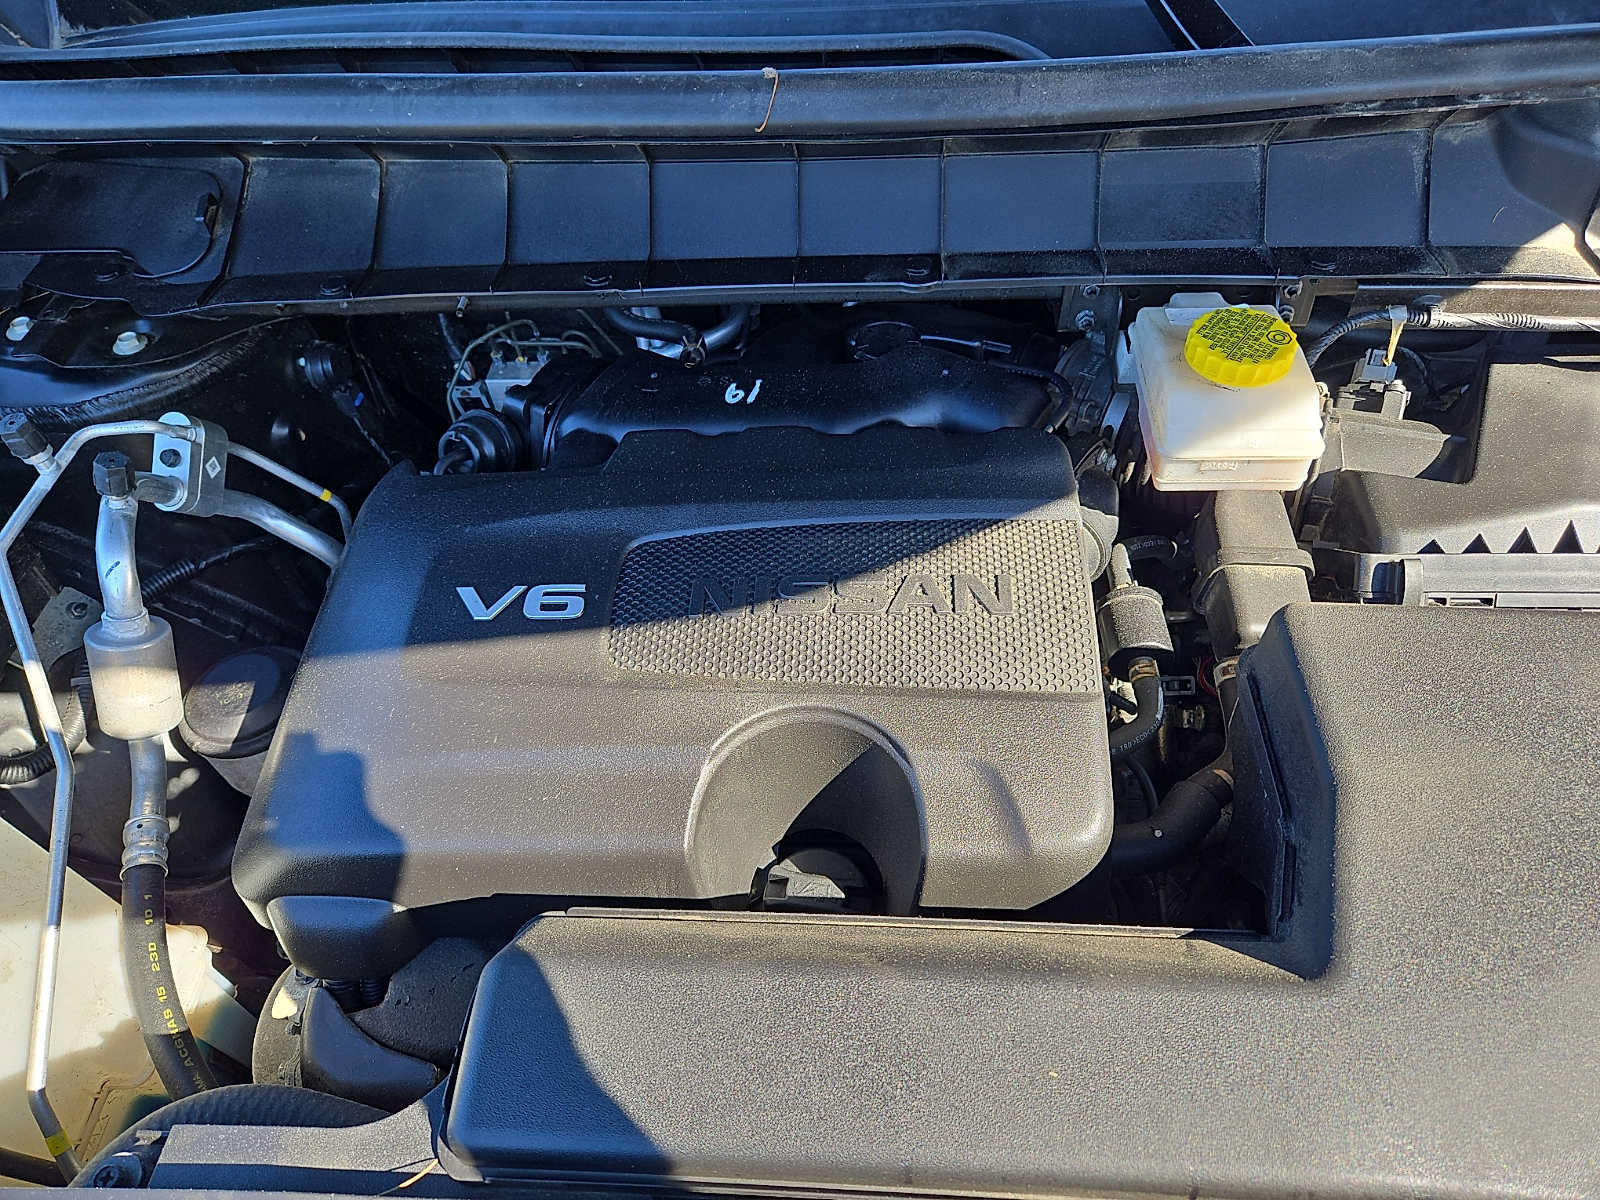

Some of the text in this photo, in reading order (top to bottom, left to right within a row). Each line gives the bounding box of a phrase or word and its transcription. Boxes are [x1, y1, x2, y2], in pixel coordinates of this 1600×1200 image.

[455, 583, 587, 620] V6
[688, 574, 1014, 616] NISSAN
[148, 942, 160, 972] 23D
